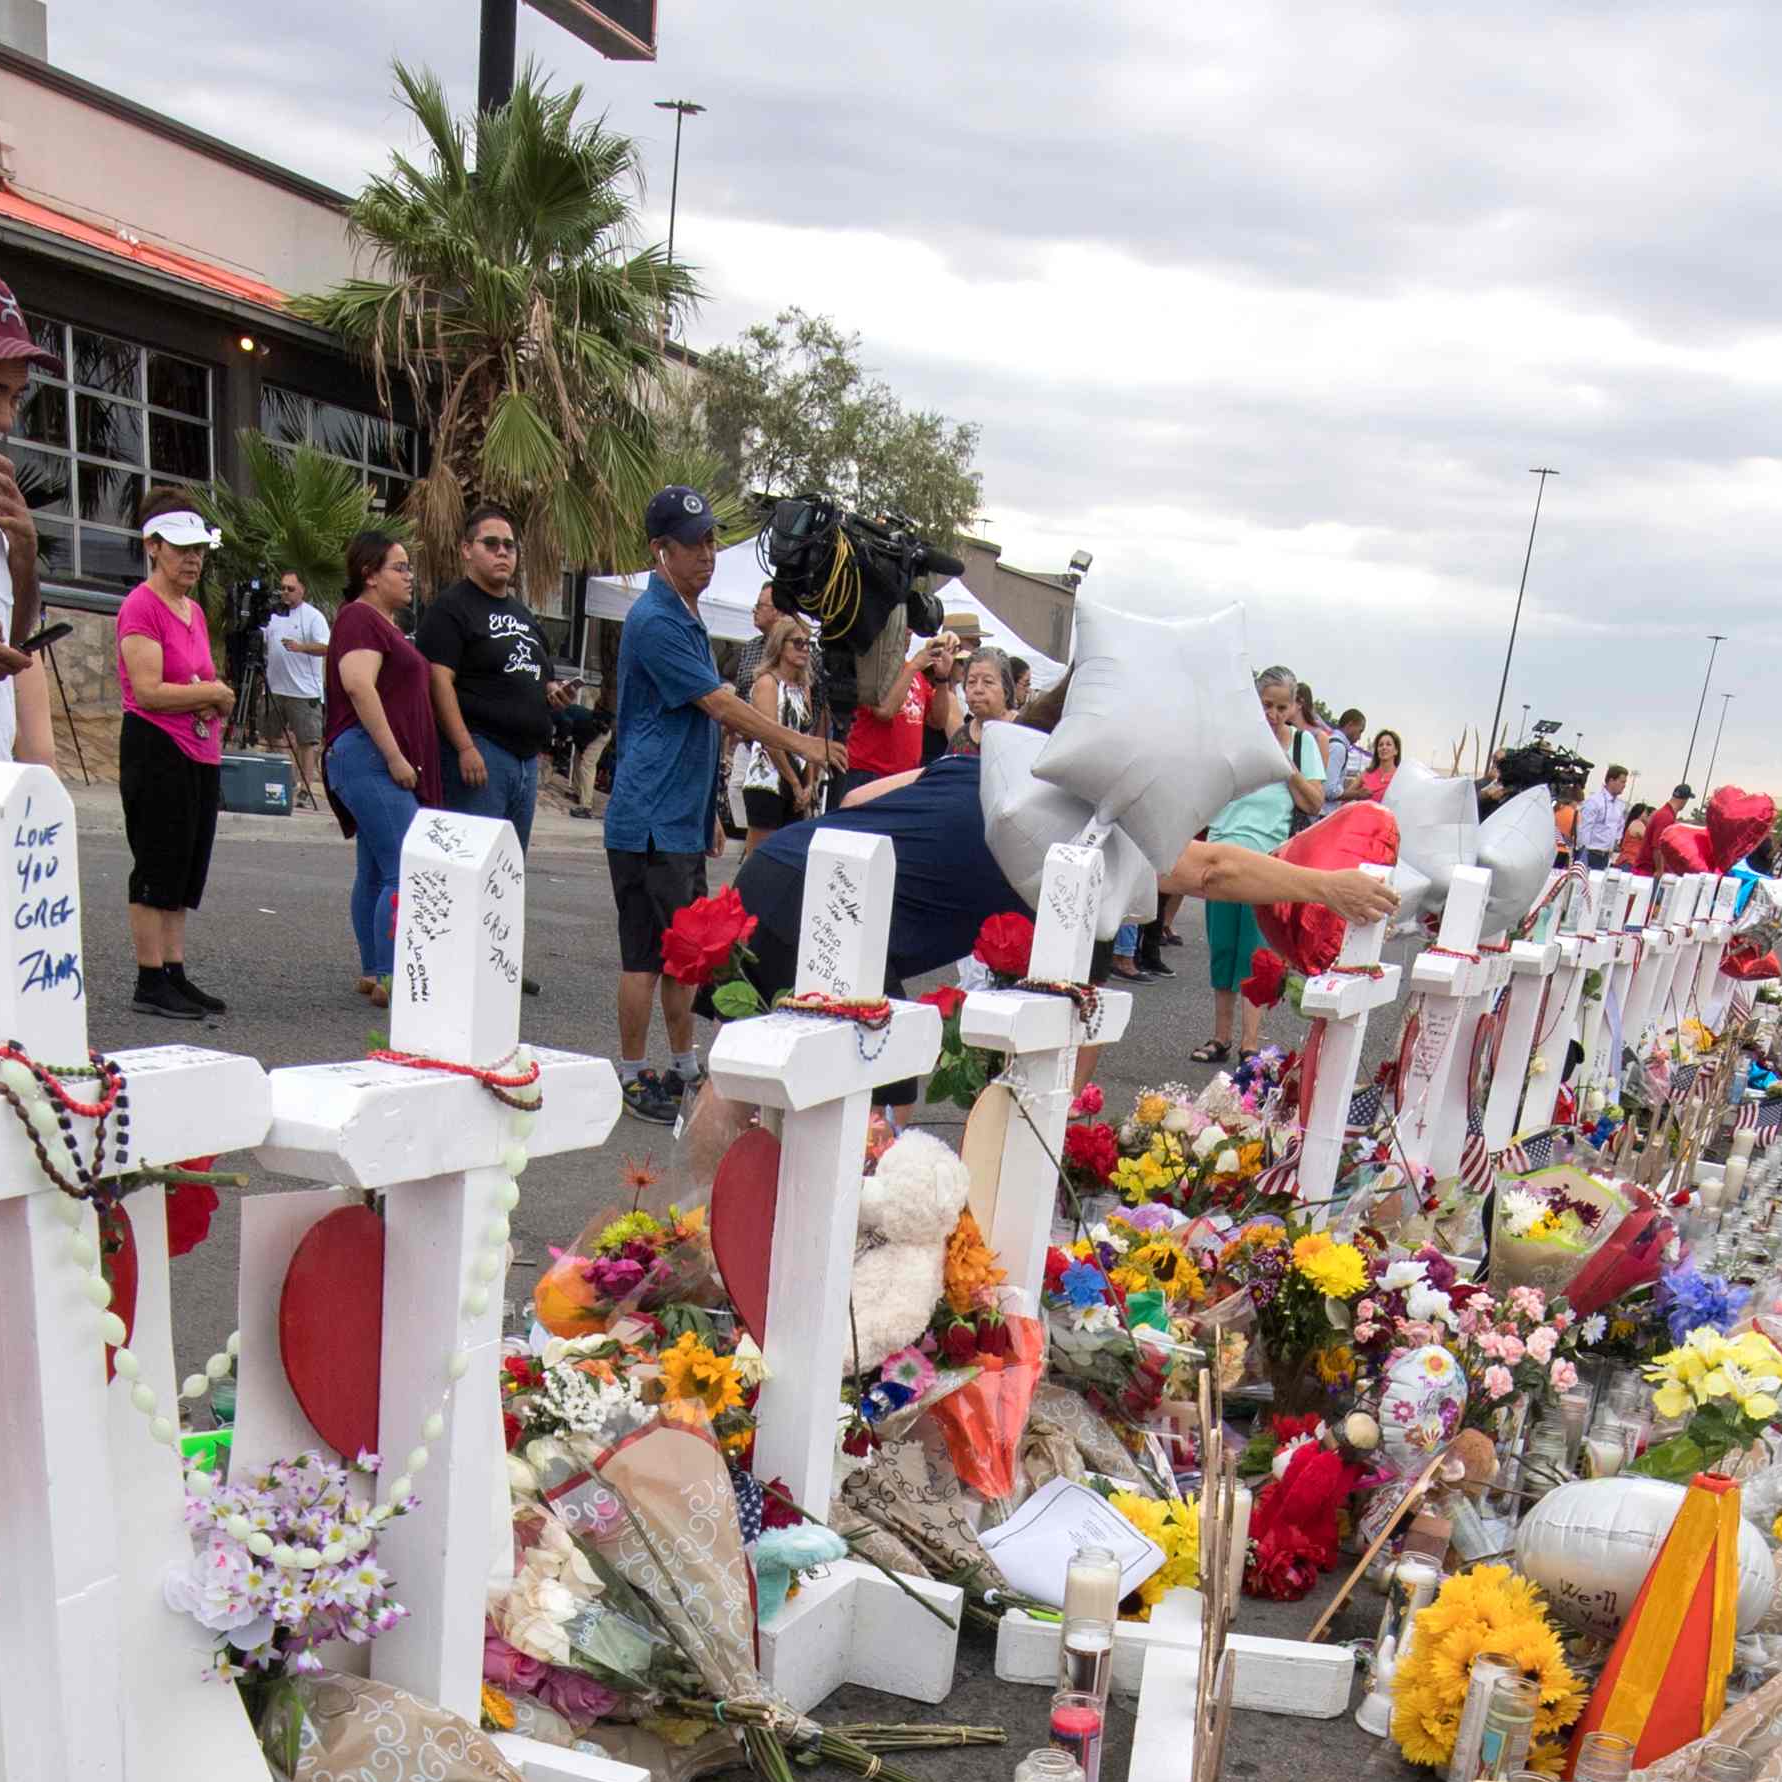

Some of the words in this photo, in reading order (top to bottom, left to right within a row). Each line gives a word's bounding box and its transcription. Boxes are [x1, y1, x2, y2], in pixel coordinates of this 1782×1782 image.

[488, 613, 503, 631] El
[504, 653, 542, 681] Strong
[14, 822, 63, 849] LOVE
